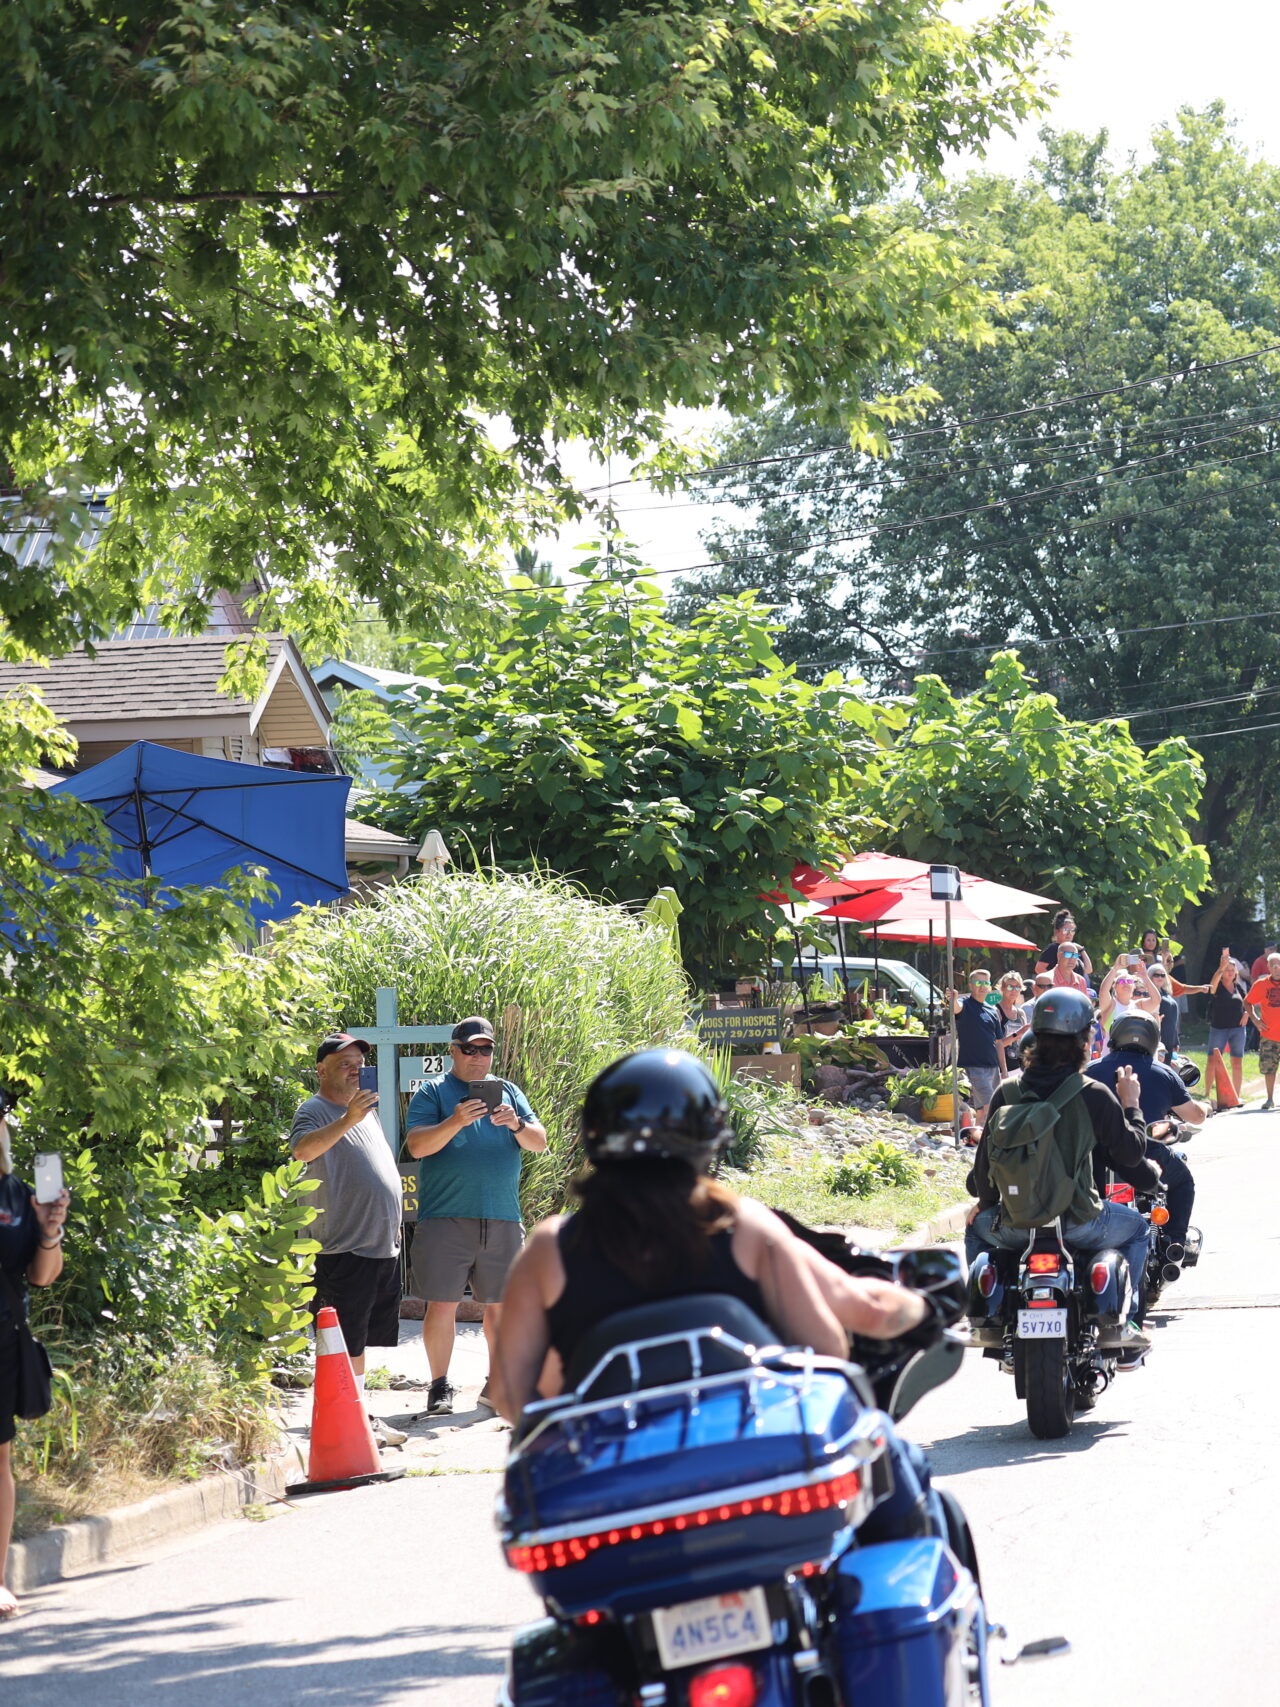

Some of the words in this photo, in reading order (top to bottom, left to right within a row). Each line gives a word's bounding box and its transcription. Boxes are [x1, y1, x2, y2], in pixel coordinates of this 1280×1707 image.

[702, 1017, 723, 1028] HOGS
[725, 1016, 741, 1027] FOR
[742, 1014, 777, 1027] HOSPICE
[702, 1031, 727, 1039] JULY
[730, 1028, 777, 1039] 29/30/31
[424, 1057, 443, 1073] 23
[401, 1176, 417, 1193] GS
[404, 1198, 419, 1211] LY
[672, 1609, 758, 1649] 4N5C4
